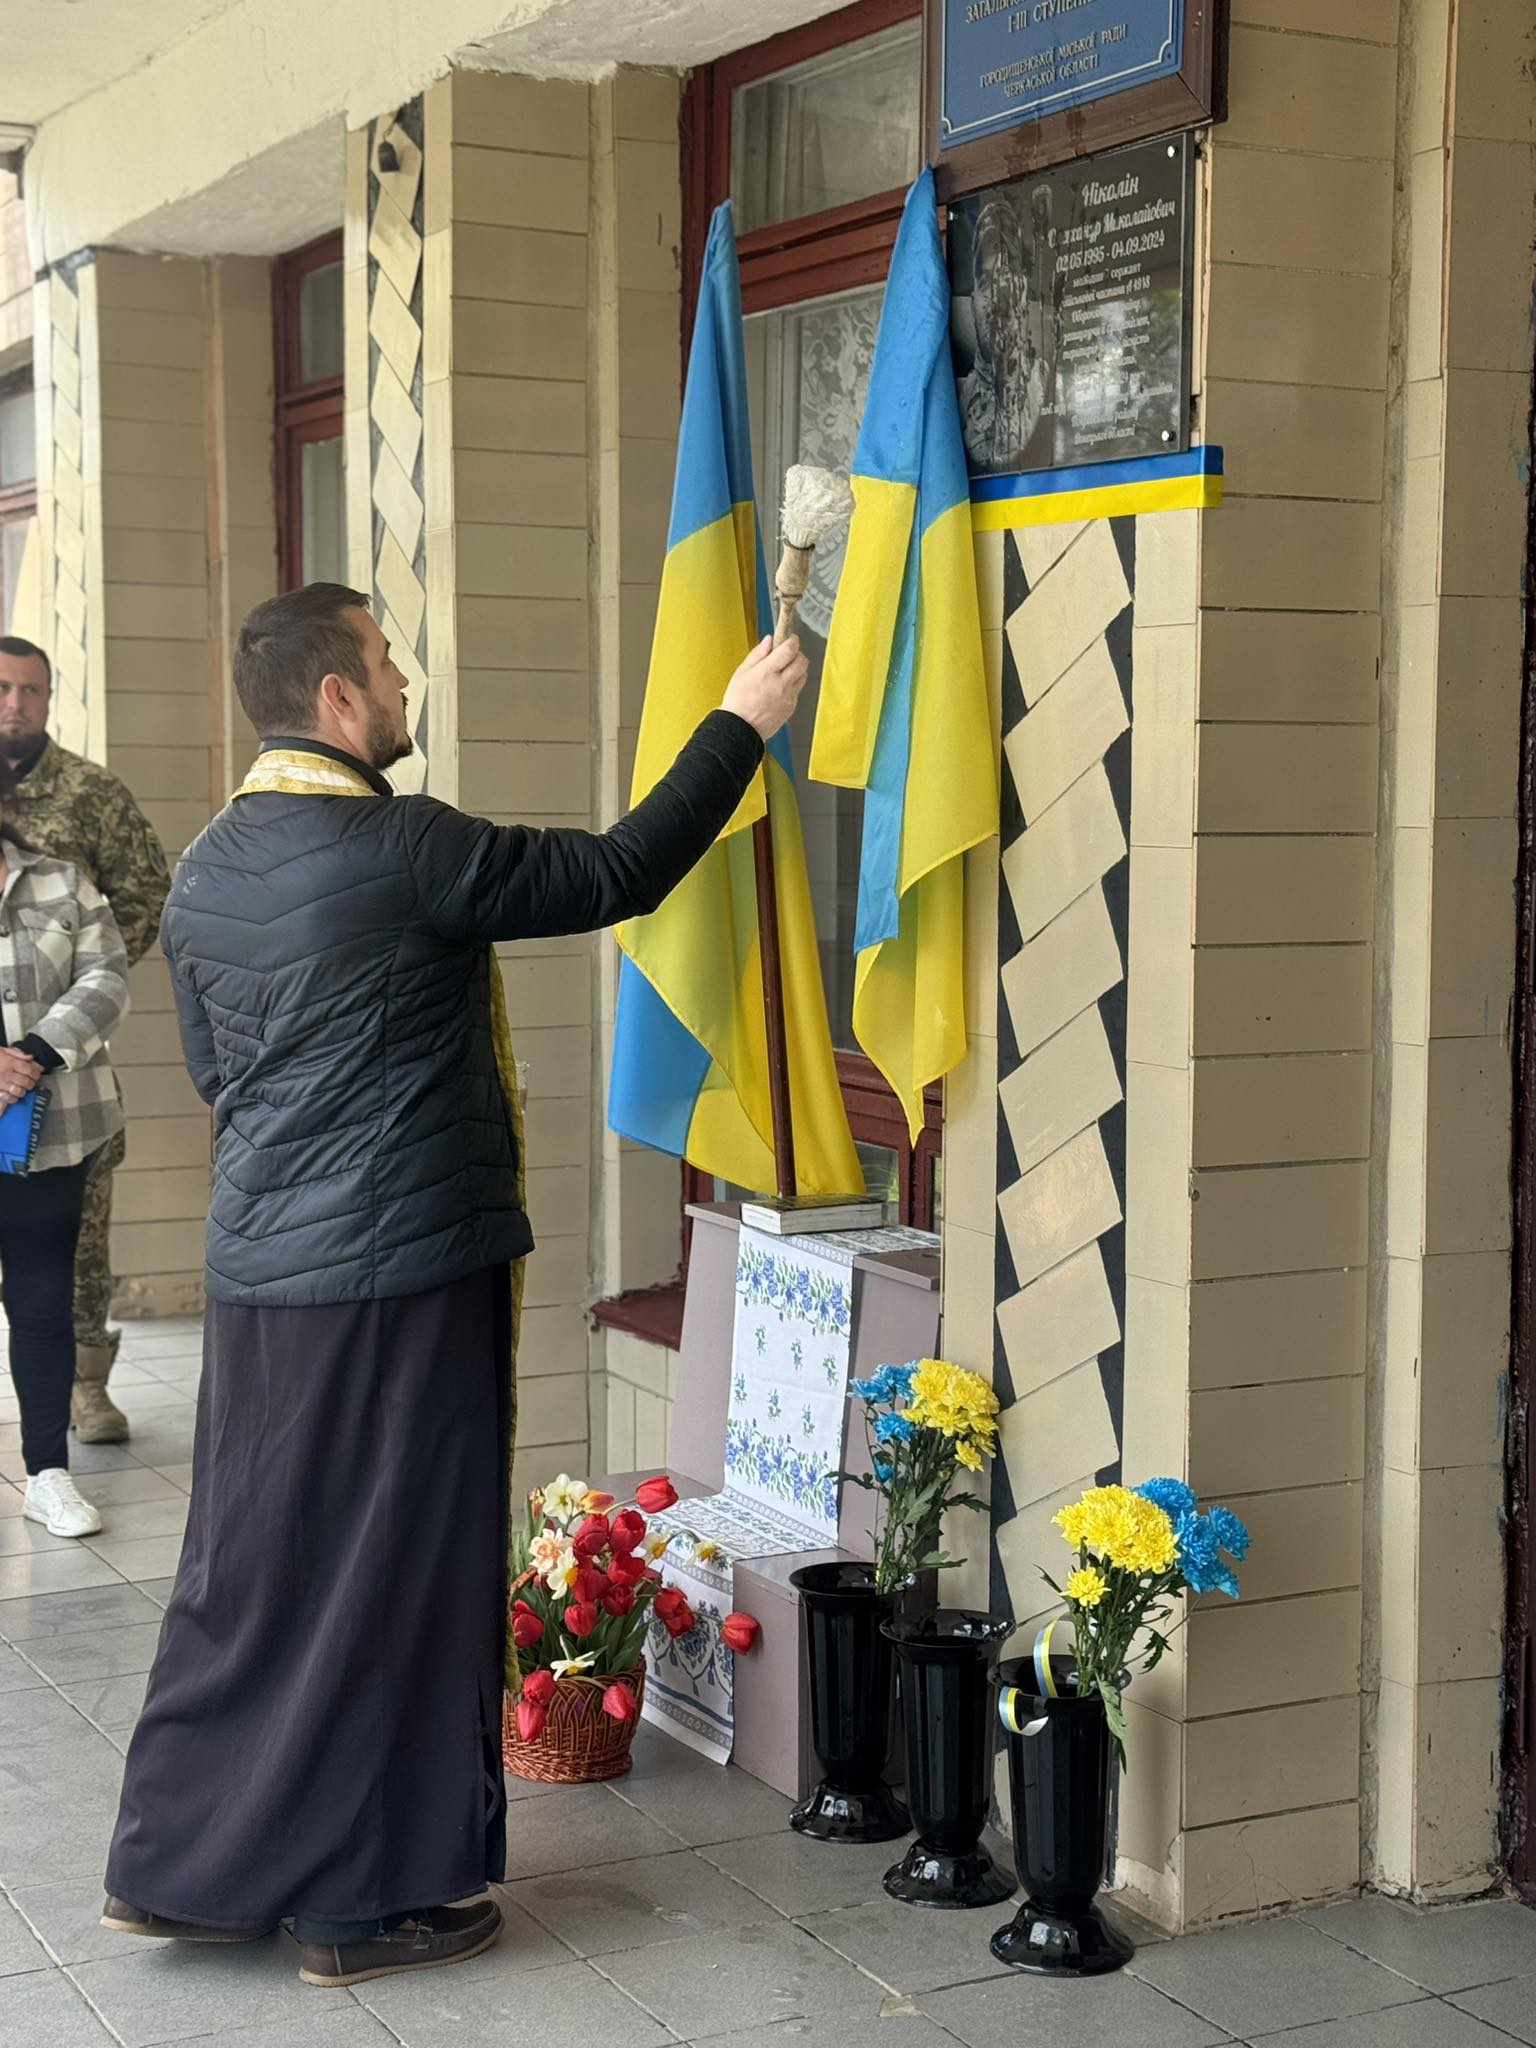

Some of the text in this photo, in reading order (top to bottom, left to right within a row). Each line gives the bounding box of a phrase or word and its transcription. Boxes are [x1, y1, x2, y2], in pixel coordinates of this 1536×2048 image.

[1033, 0, 1095, 23] СТУПЕ
[1059, 32, 1097, 59] МІСЬКОЇ
[1101, 24, 1127, 44] РАДИ
[1004, 55, 1099, 97] ЧЕРКАСЬКОЇ ОБЛАСТІ
[1082, 172, 1139, 206] Ніколін
[1111, 229, 1165, 259] 04.09.2024
